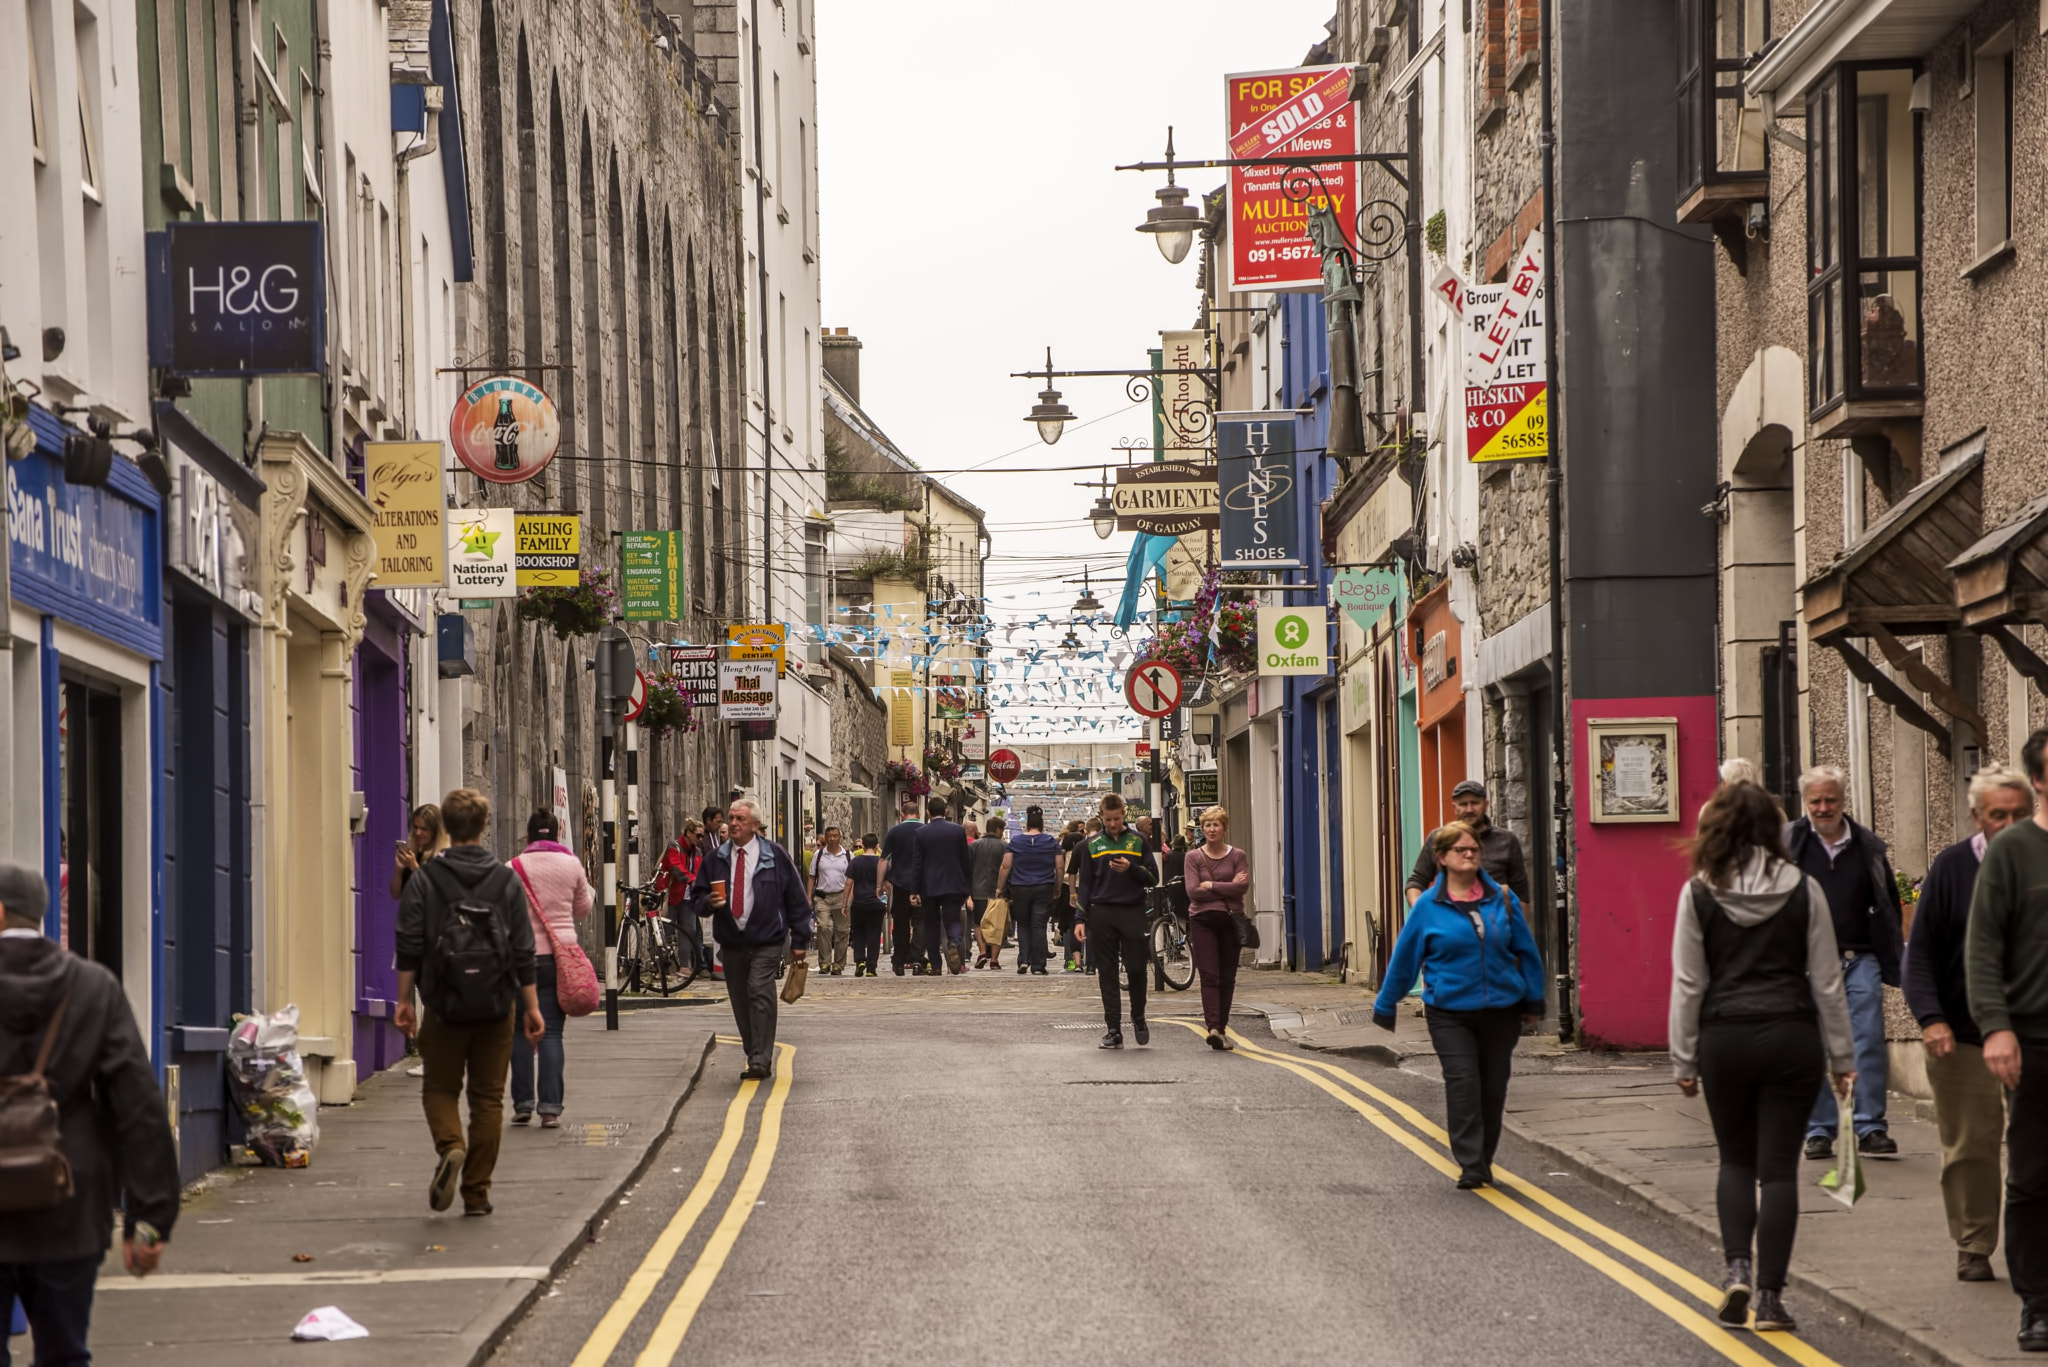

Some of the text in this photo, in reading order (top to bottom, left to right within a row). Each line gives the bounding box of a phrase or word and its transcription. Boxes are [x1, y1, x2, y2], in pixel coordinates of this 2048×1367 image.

[1239, 80, 1283, 101] FOR
[1289, 76, 1324, 96] SA
[1250, 105, 1258, 113] In
[1261, 93, 1324, 145] SOLD
[1336, 114, 1347, 128] &
[1291, 138, 1332, 152] Mews
[1244, 167, 1270, 178] Mixed
[1243, 181, 1280, 194] (Tenants
[1283, 181, 1299, 189] Nt
[1242, 193, 1345, 221] MULLERY
[189, 264, 298, 314] H&G
[1479, 254, 1540, 364] LET BY
[1507, 363, 1536, 378] LET
[1173, 344, 1197, 419] Thought
[470, 382, 540, 402] ALWAYS
[1467, 386, 1526, 407] HESKIN
[1467, 409, 1506, 428] & CO
[1502, 432, 1548, 449] 56585
[372, 461, 433, 489] Olga's
[1135, 464, 1201, 479] ESTABLISHED 1989
[1245, 423, 1271, 544] HYNES
[1115, 488, 1219, 509] GARMENTS
[7, 465, 44, 552] Sana
[47, 486, 83, 570] Trust
[373, 510, 438, 527] ALTERATIONS
[1137, 517, 1201, 533] OF GALWAY
[518, 522, 572, 535] AISLING
[396, 534, 417, 549] AND
[520, 538, 571, 550] FAMILY
[515, 556, 576, 567] BOOKSHOP
[1235, 547, 1286, 560] SHOES
[381, 556, 433, 573] TAILORING
[453, 563, 508, 574] National
[457, 575, 504, 586] Lottery
[1339, 580, 1390, 601] Regis
[1347, 602, 1385, 612] Boutique
[1267, 653, 1319, 668] Oxfam
[672, 661, 716, 678] GENTS
[723, 664, 773, 674] Heng Heng
[735, 675, 760, 690] Thai
[722, 689, 774, 706] Massage
